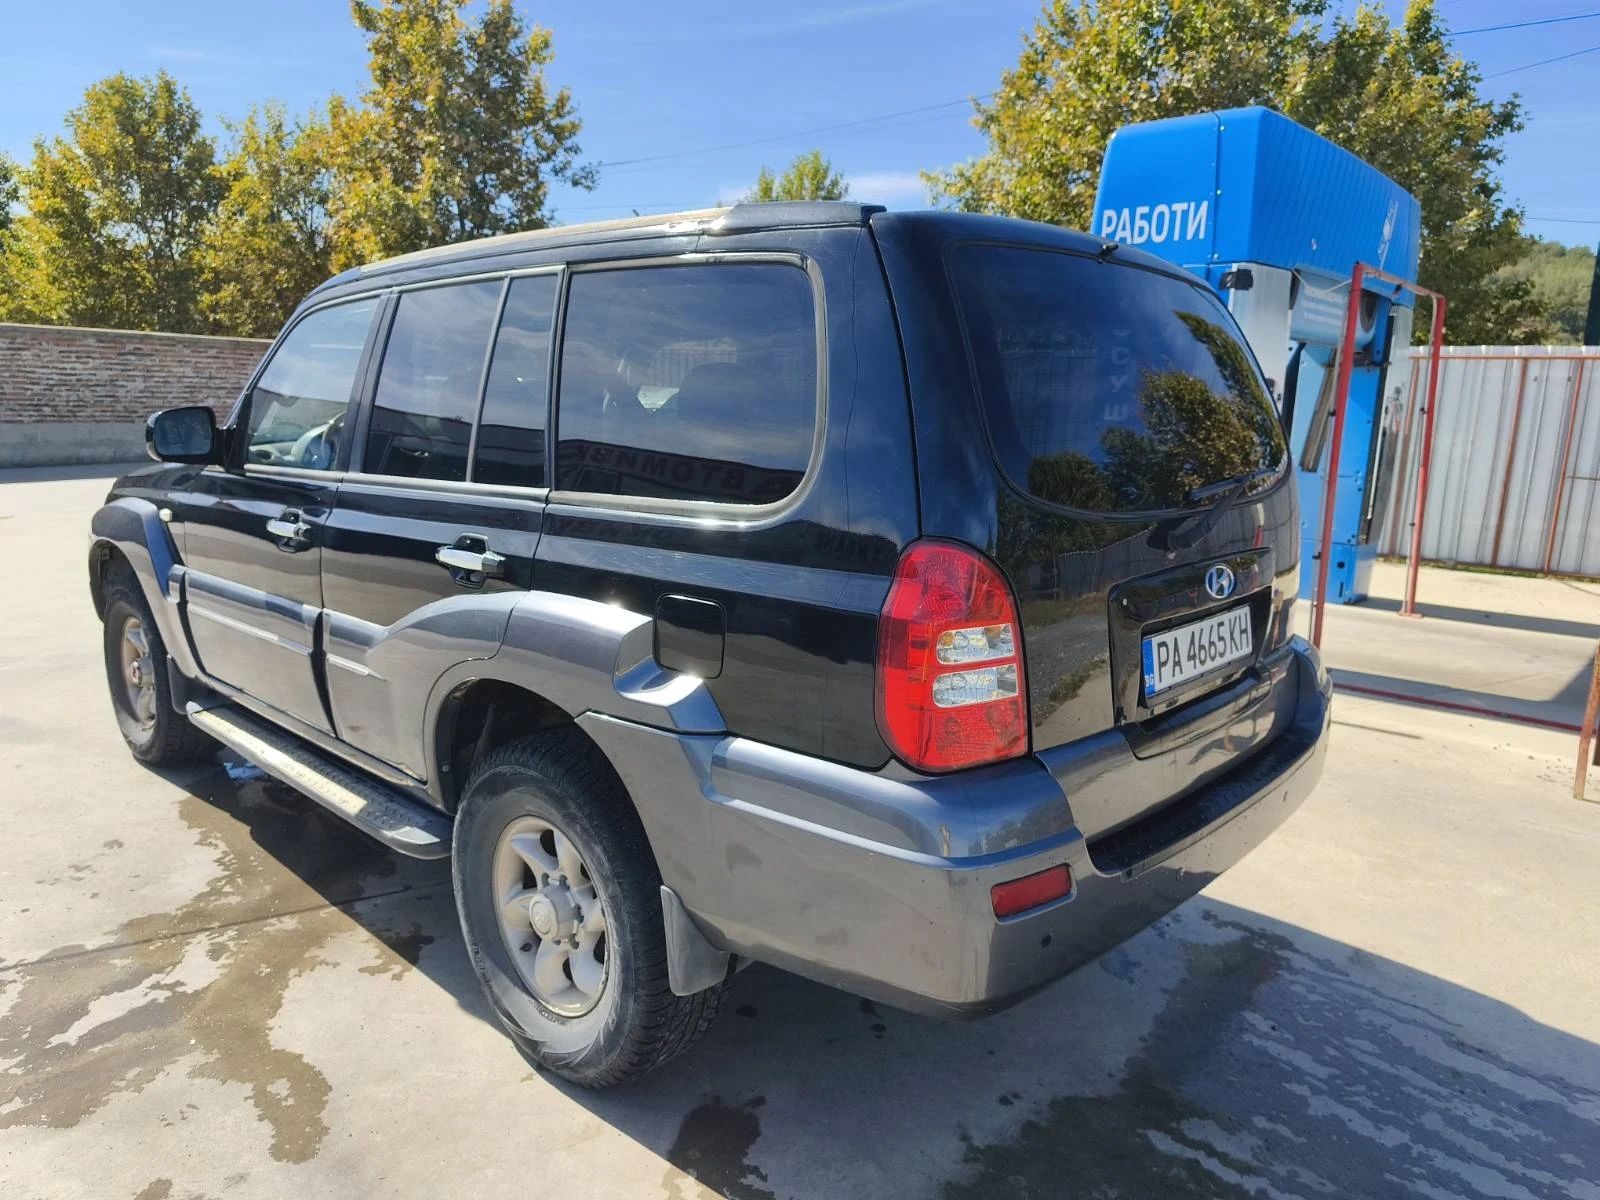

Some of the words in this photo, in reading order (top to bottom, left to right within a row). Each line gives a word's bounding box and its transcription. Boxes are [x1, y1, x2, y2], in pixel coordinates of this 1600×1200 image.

[1101, 200, 1209, 244] РАБОТИ
[1157, 637, 1183, 683] PA
[1187, 621, 1227, 669] 4665
